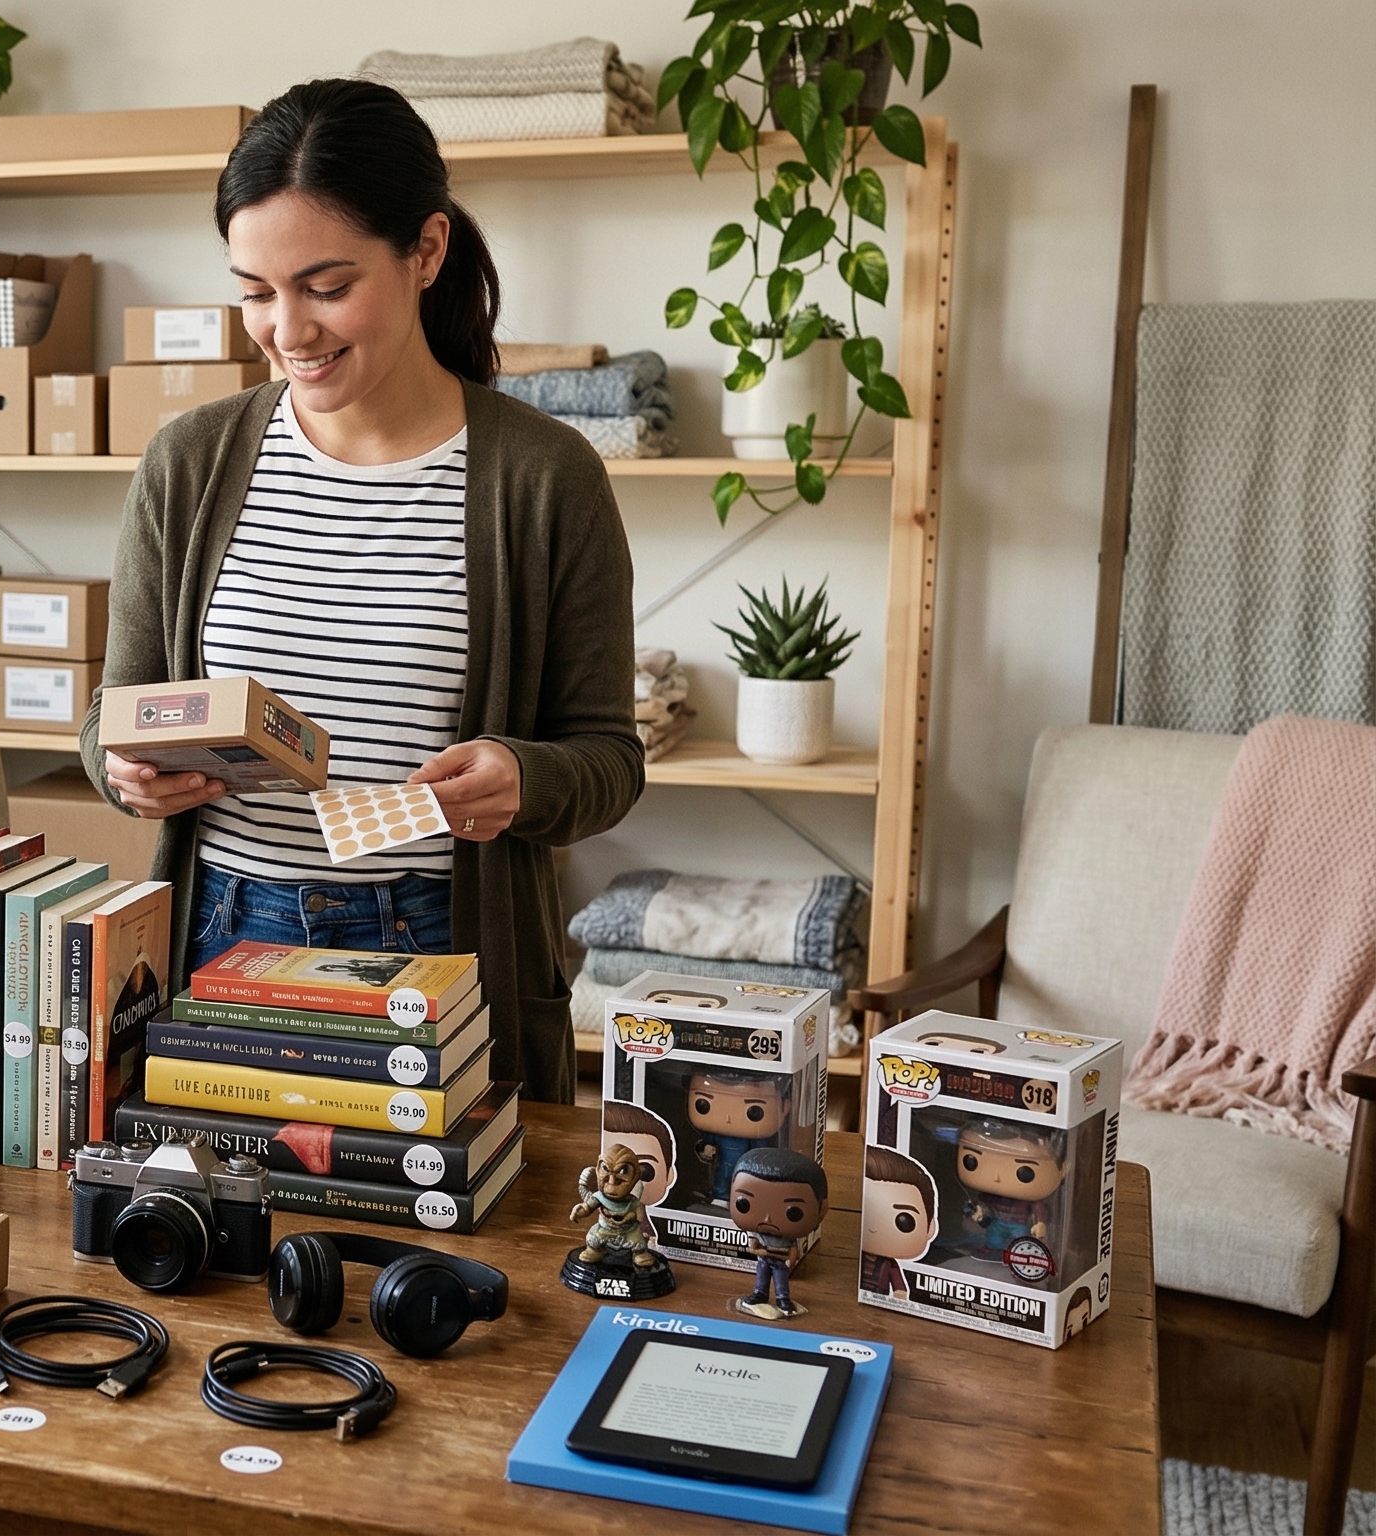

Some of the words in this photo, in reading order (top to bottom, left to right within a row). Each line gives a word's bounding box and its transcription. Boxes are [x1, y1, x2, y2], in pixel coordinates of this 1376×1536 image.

[750, 1035, 781, 1055] 295
[1024, 1085, 1053, 1107] 318
[404, 1157, 443, 1172] $14.99
[417, 1204, 455, 1217] $18.50
[667, 1219, 710, 1241] LIMITED
[712, 1227, 748, 1246] EDITIO
[915, 1273, 976, 1302] LIMITED
[980, 1288, 1041, 1317] EDITION
[611, 1311, 700, 1335] kindle
[694, 1362, 761, 1382] kindle
